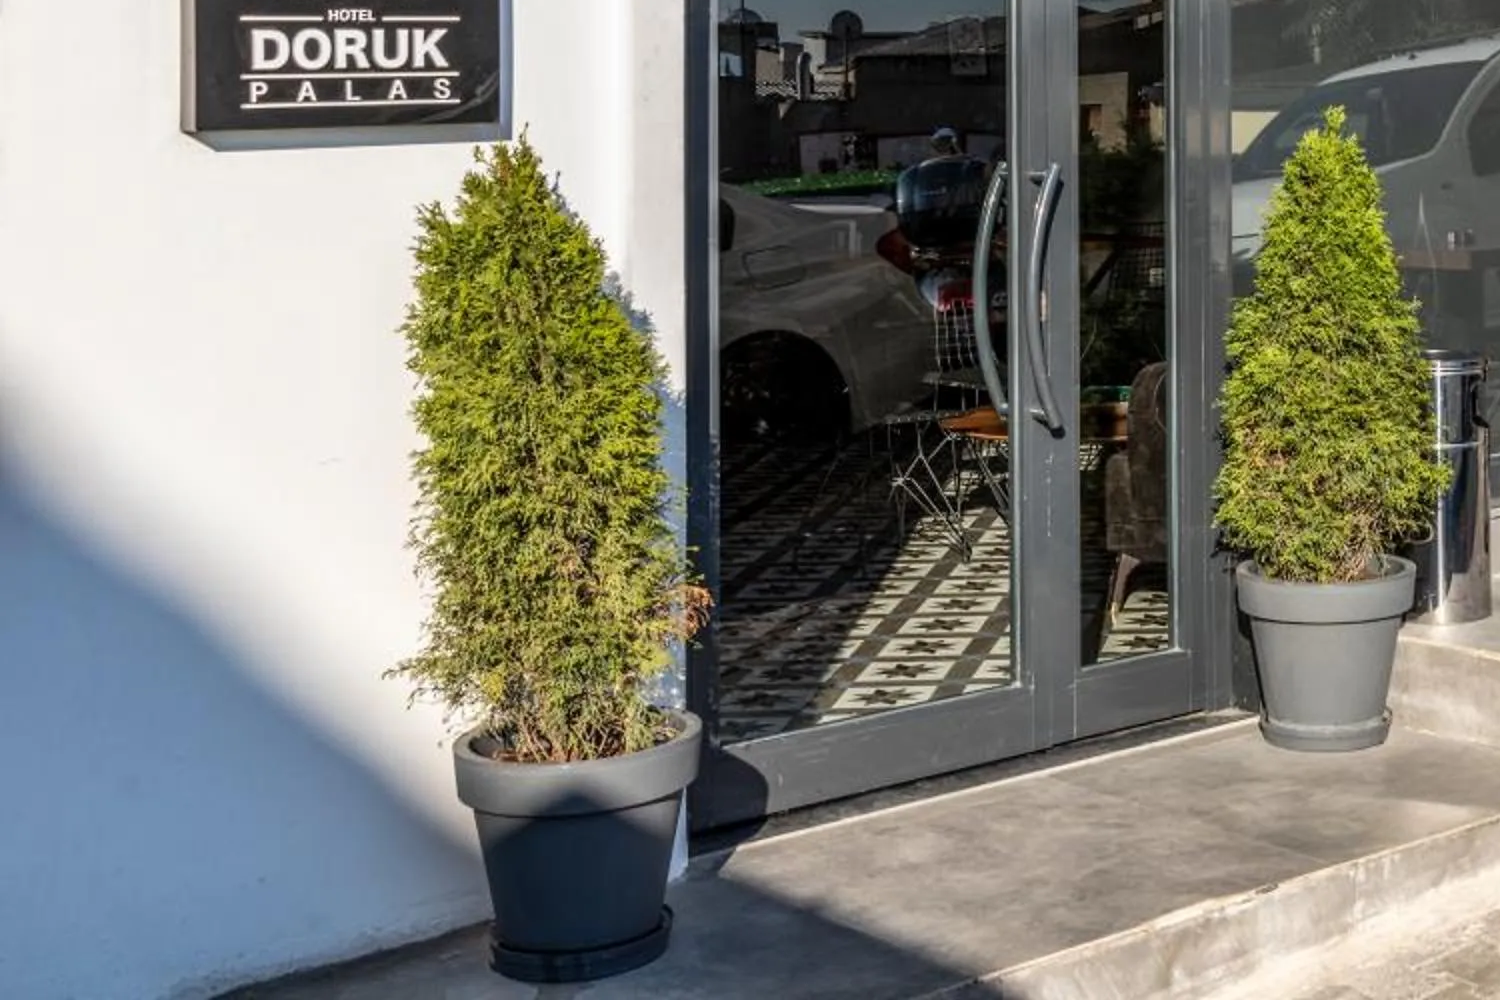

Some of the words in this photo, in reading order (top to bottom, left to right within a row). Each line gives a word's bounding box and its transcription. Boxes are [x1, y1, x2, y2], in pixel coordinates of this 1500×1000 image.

[327, 9, 377, 22] HOTEL
[250, 28, 450, 71] DORUK
[250, 78, 452, 102] PALAS
